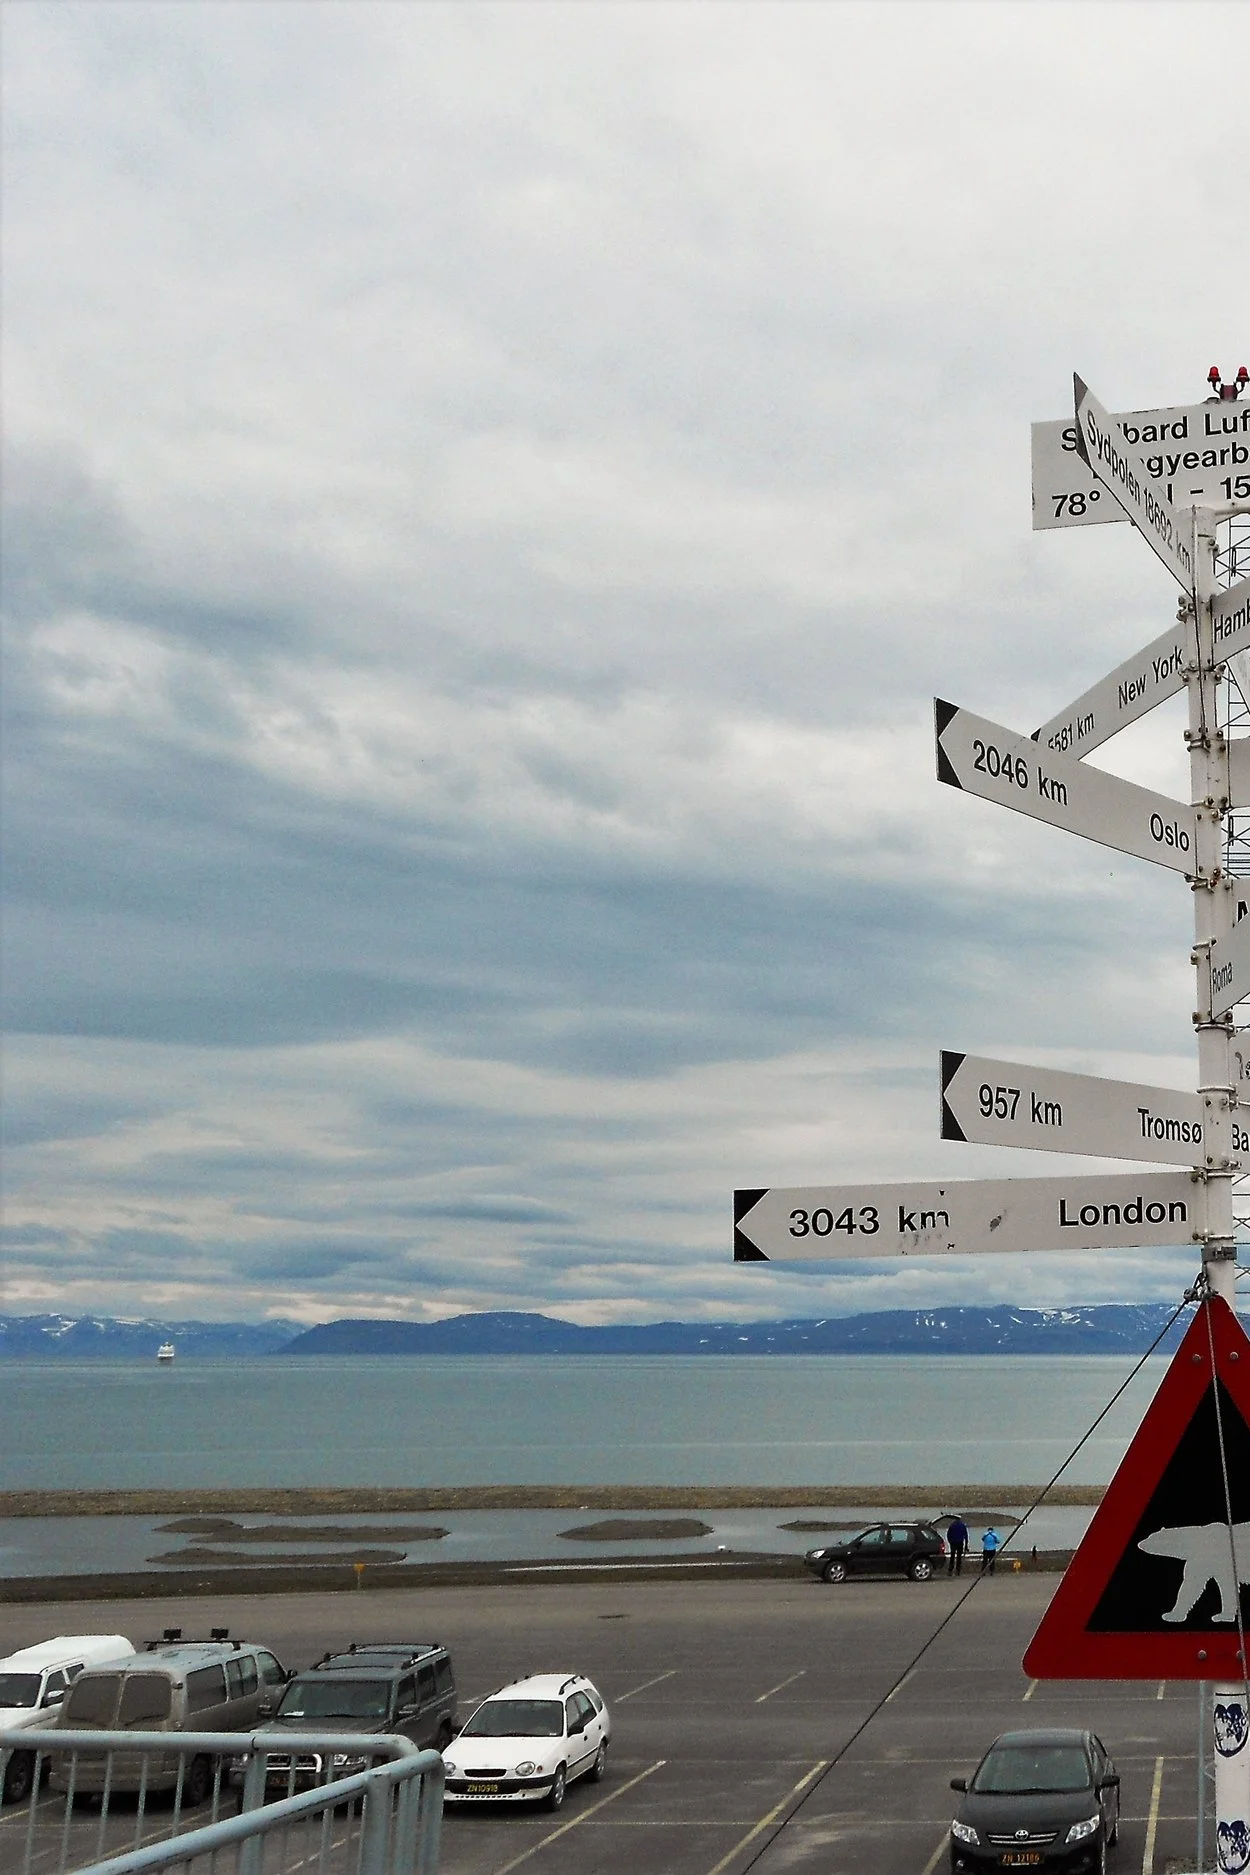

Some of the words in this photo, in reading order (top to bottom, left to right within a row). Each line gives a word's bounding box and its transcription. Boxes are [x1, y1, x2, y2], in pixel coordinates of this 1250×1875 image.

[1061, 415, 1188, 452] Sbard
[1052, 489, 1101, 518] 78°
[1087, 409, 1141, 506] Sydpolen
[1144, 487, 1173, 551] 18692
[1175, 529, 1191, 573] km
[1077, 712, 1095, 739] km
[1118, 674, 1147, 709] New
[1152, 645, 1183, 684] York
[973, 739, 1029, 789] 2046
[1038, 766, 1068, 805] km
[1150, 813, 1190, 852] Oslo
[1212, 962, 1233, 994] Roma
[979, 1084, 1021, 1120] 957
[1031, 1092, 1062, 1126] km
[1137, 1107, 1202, 1144] Tromsø
[789, 1206, 880, 1237] 3043
[899, 1205, 949, 1233] km
[1058, 1196, 1187, 1227] London
